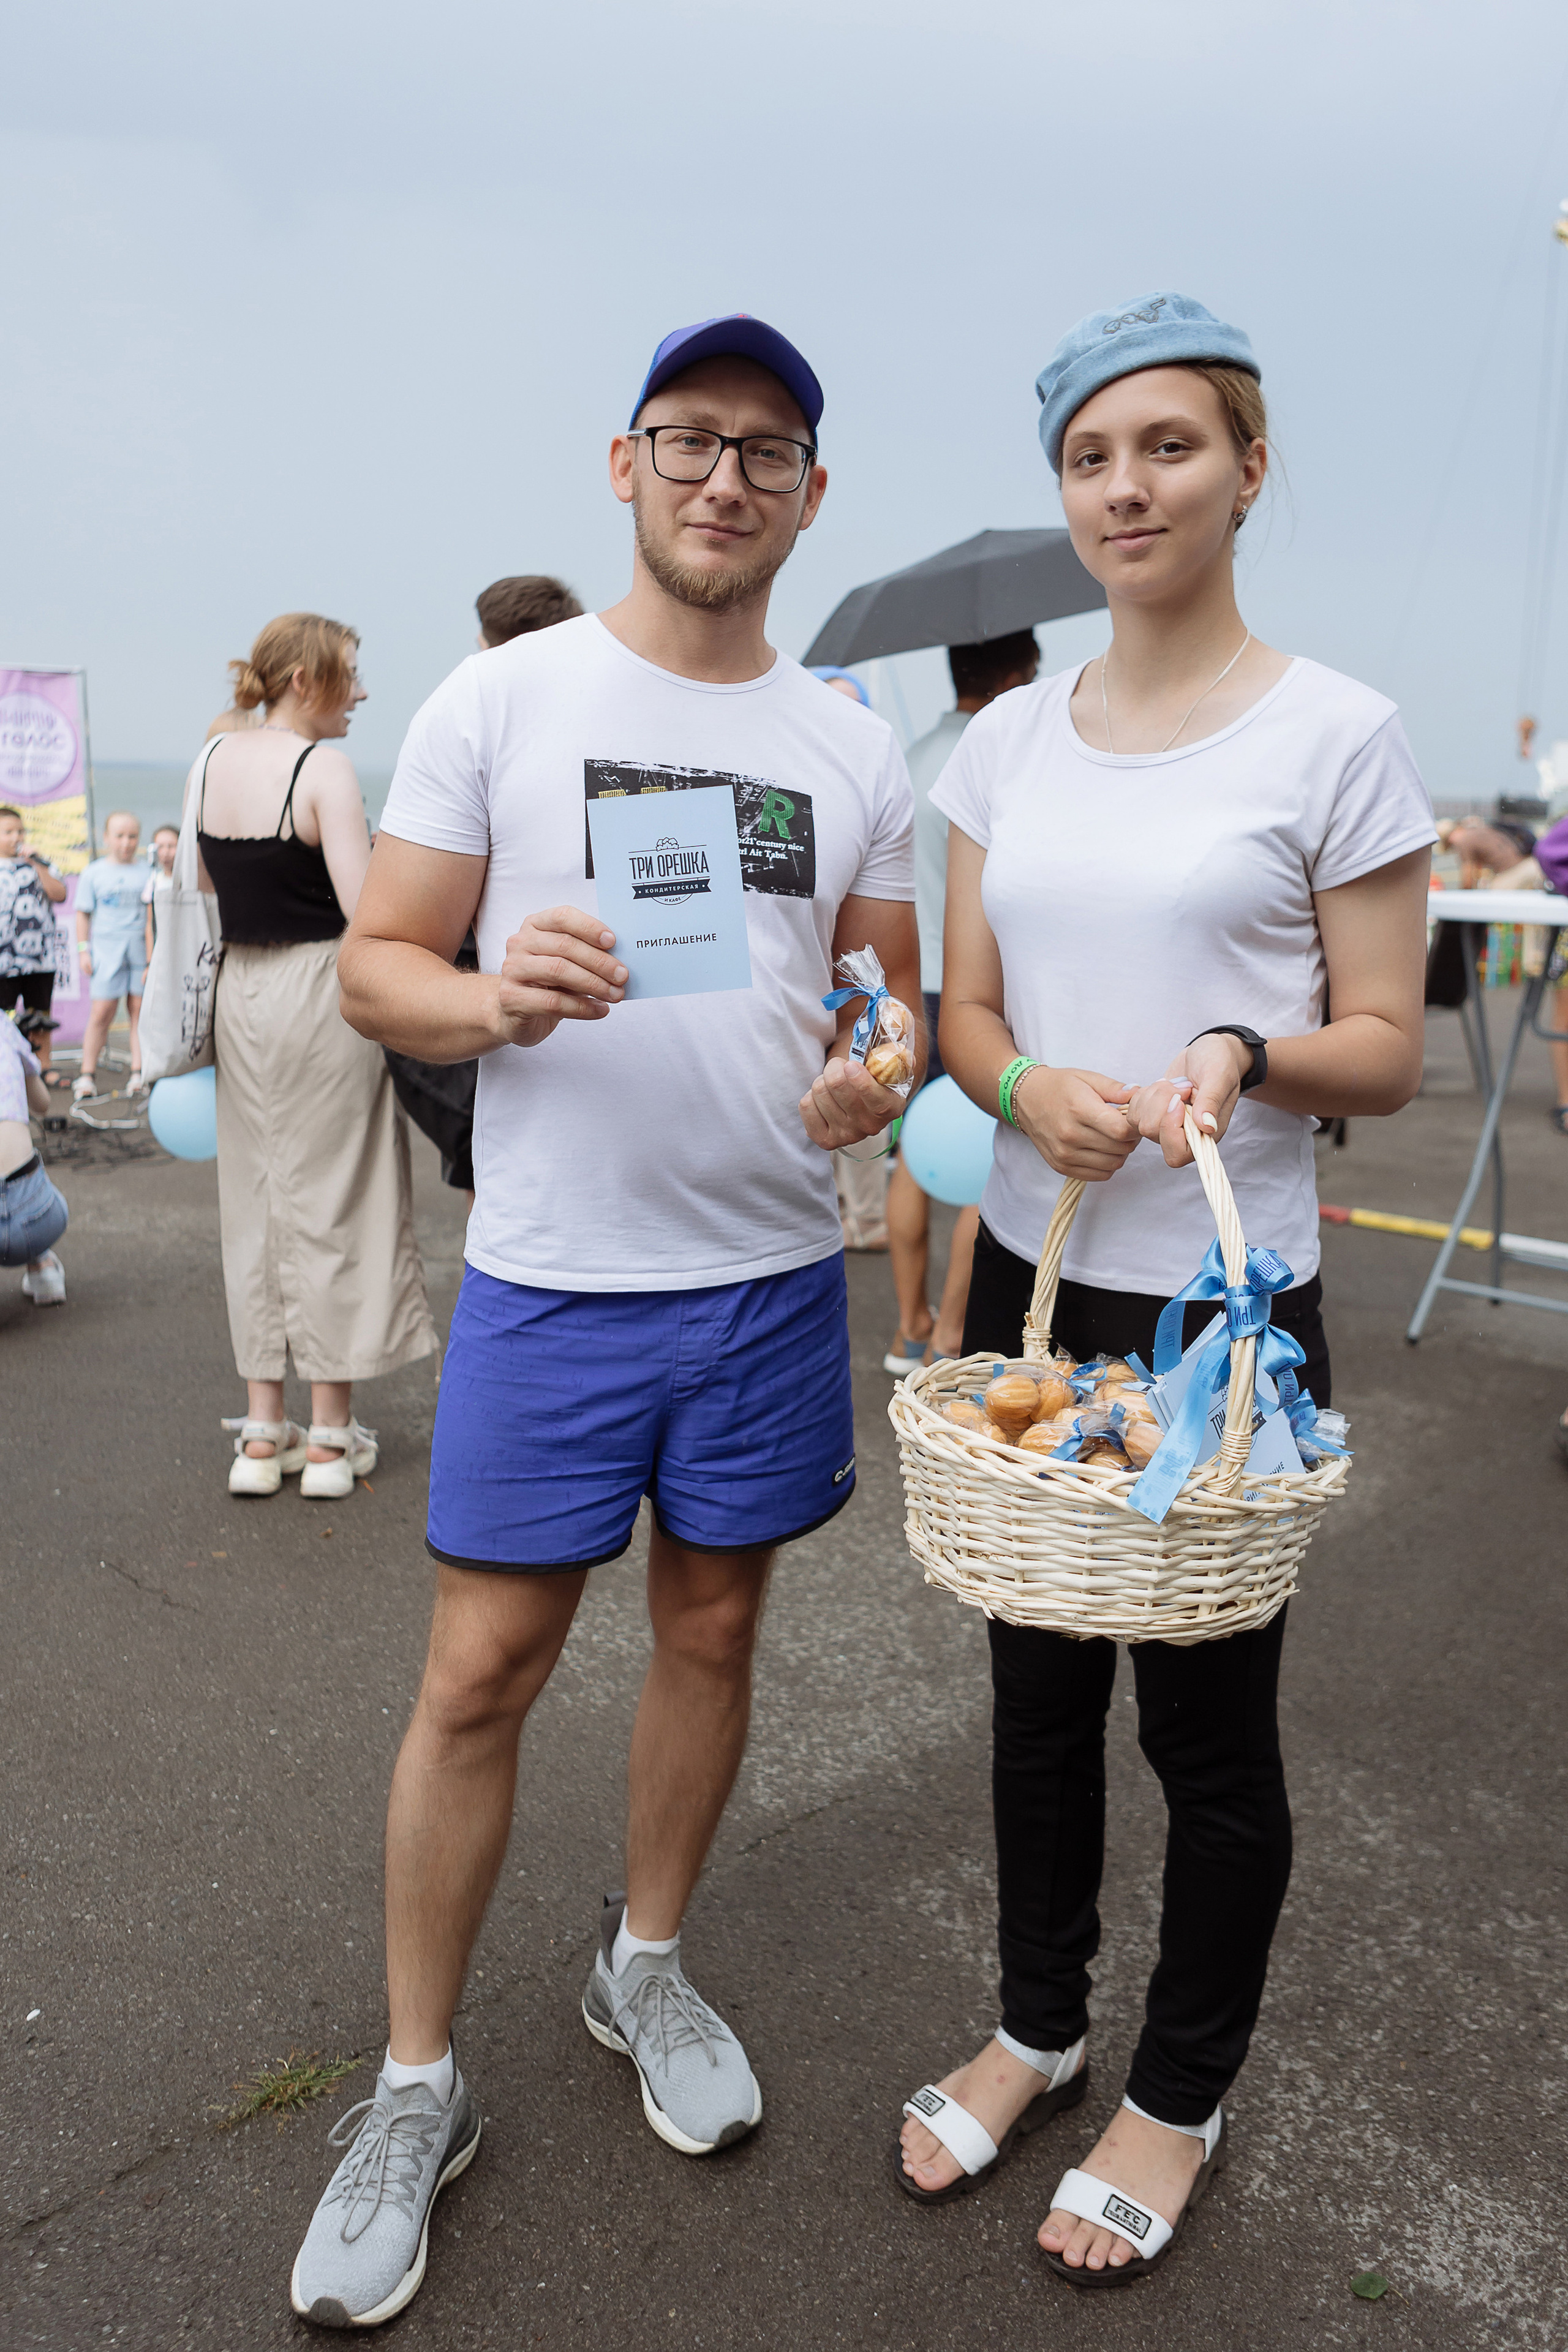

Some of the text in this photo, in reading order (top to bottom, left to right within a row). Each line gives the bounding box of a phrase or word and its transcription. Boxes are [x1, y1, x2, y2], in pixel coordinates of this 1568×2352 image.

[758, 789, 795, 840] R
[787, 843, 805, 852] nice
[629, 851, 709, 880] ТРИ ОРЕШКА
[645, 884, 698, 894] КОНДИТЕРСКАЯ
[636, 933, 717, 949] ПРИГЛАШЕНИЕ
[1234, 1305, 1256, 1327] ТРИ
[1115, 2204, 1142, 2225] FEC
